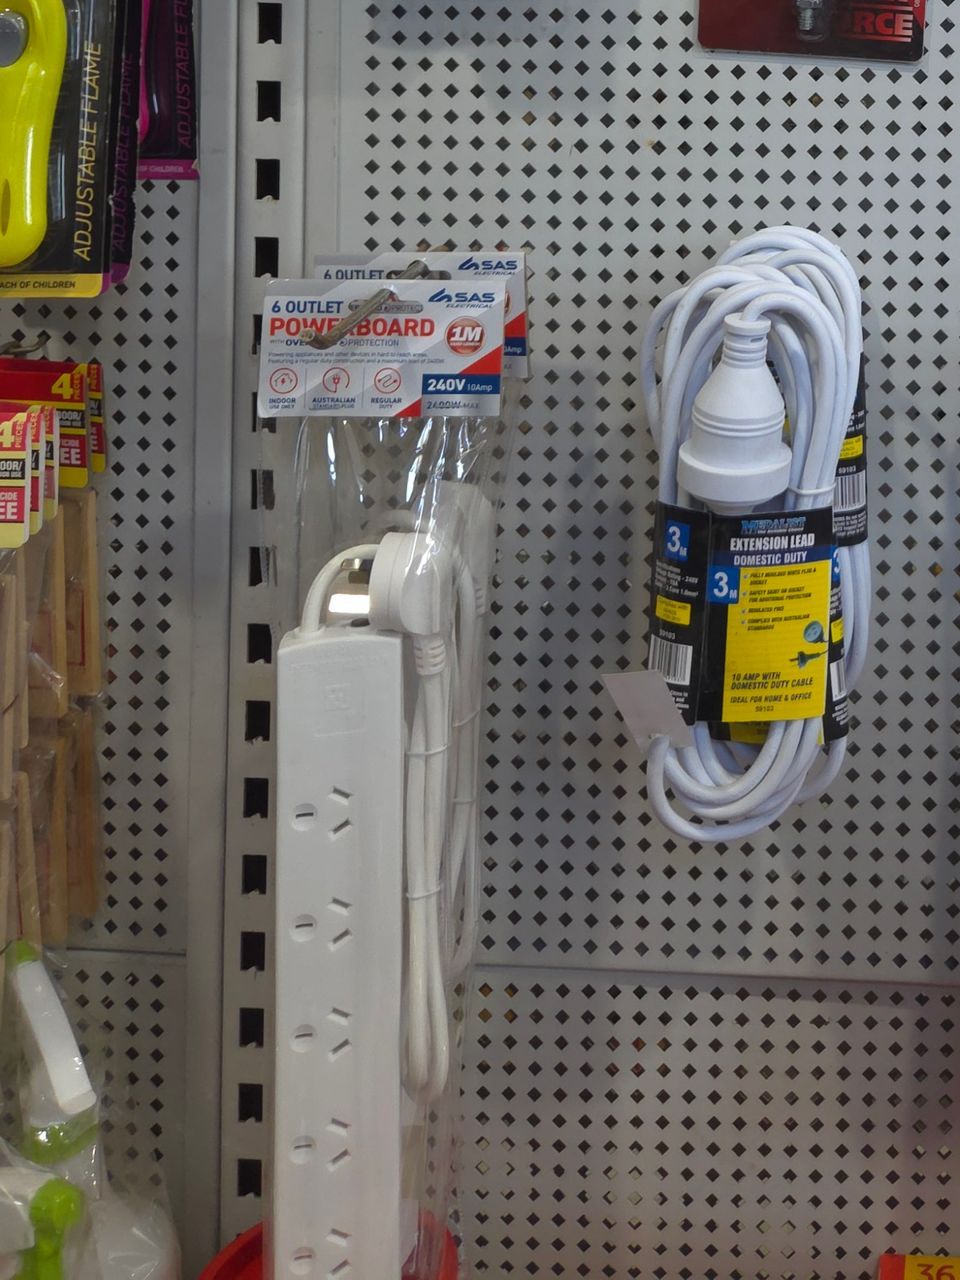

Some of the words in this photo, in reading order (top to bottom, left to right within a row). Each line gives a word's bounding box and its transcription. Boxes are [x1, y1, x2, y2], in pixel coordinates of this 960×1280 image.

[81, 40, 103, 115] FLAME
[73, 120, 98, 262] ADJUSTABLE
[271, 300, 281, 313] 6
[285, 300, 344, 314] OUTLET
[449, 326, 484, 342] 1M
[348, 338, 399, 348] PROTECTION
[51, 373, 73, 400] 4
[427, 378, 466, 392] 240V
[467, 383, 493, 393] 10Amp
[729, 536, 788, 551] EXTENSION
[789, 532, 815, 547] LEAD
[733, 554, 782, 566] DOMESTIC
[783, 551, 808, 563] DUTY
[731, 681, 769, 690] DOMESTIC
[770, 680, 790, 689] DUTY
[791, 677, 814, 687] CABLE
[916, 1262, 956, 1280] 36
